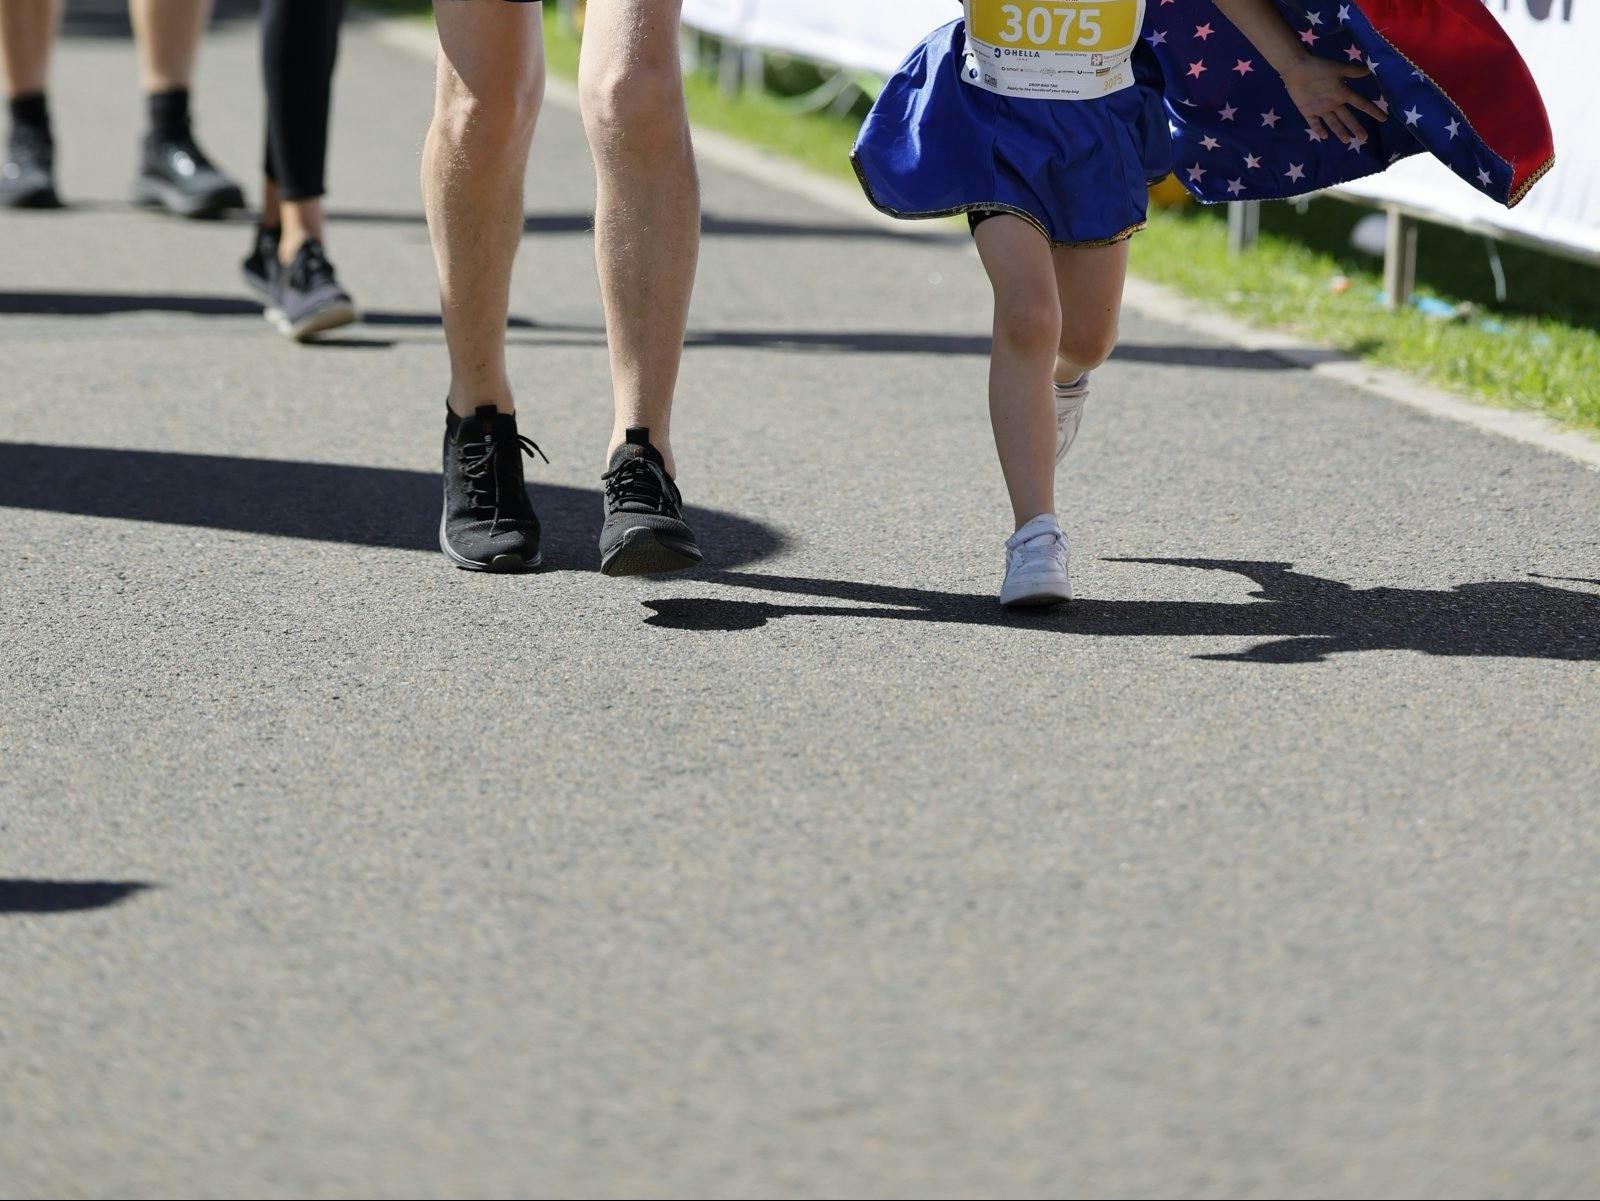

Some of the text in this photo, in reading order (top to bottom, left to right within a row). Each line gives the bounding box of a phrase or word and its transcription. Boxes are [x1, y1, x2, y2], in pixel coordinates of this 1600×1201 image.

[999, 3, 1101, 47] 3075
[1004, 49, 1040, 58] GHELLA
[1104, 74, 1123, 91] 3075
